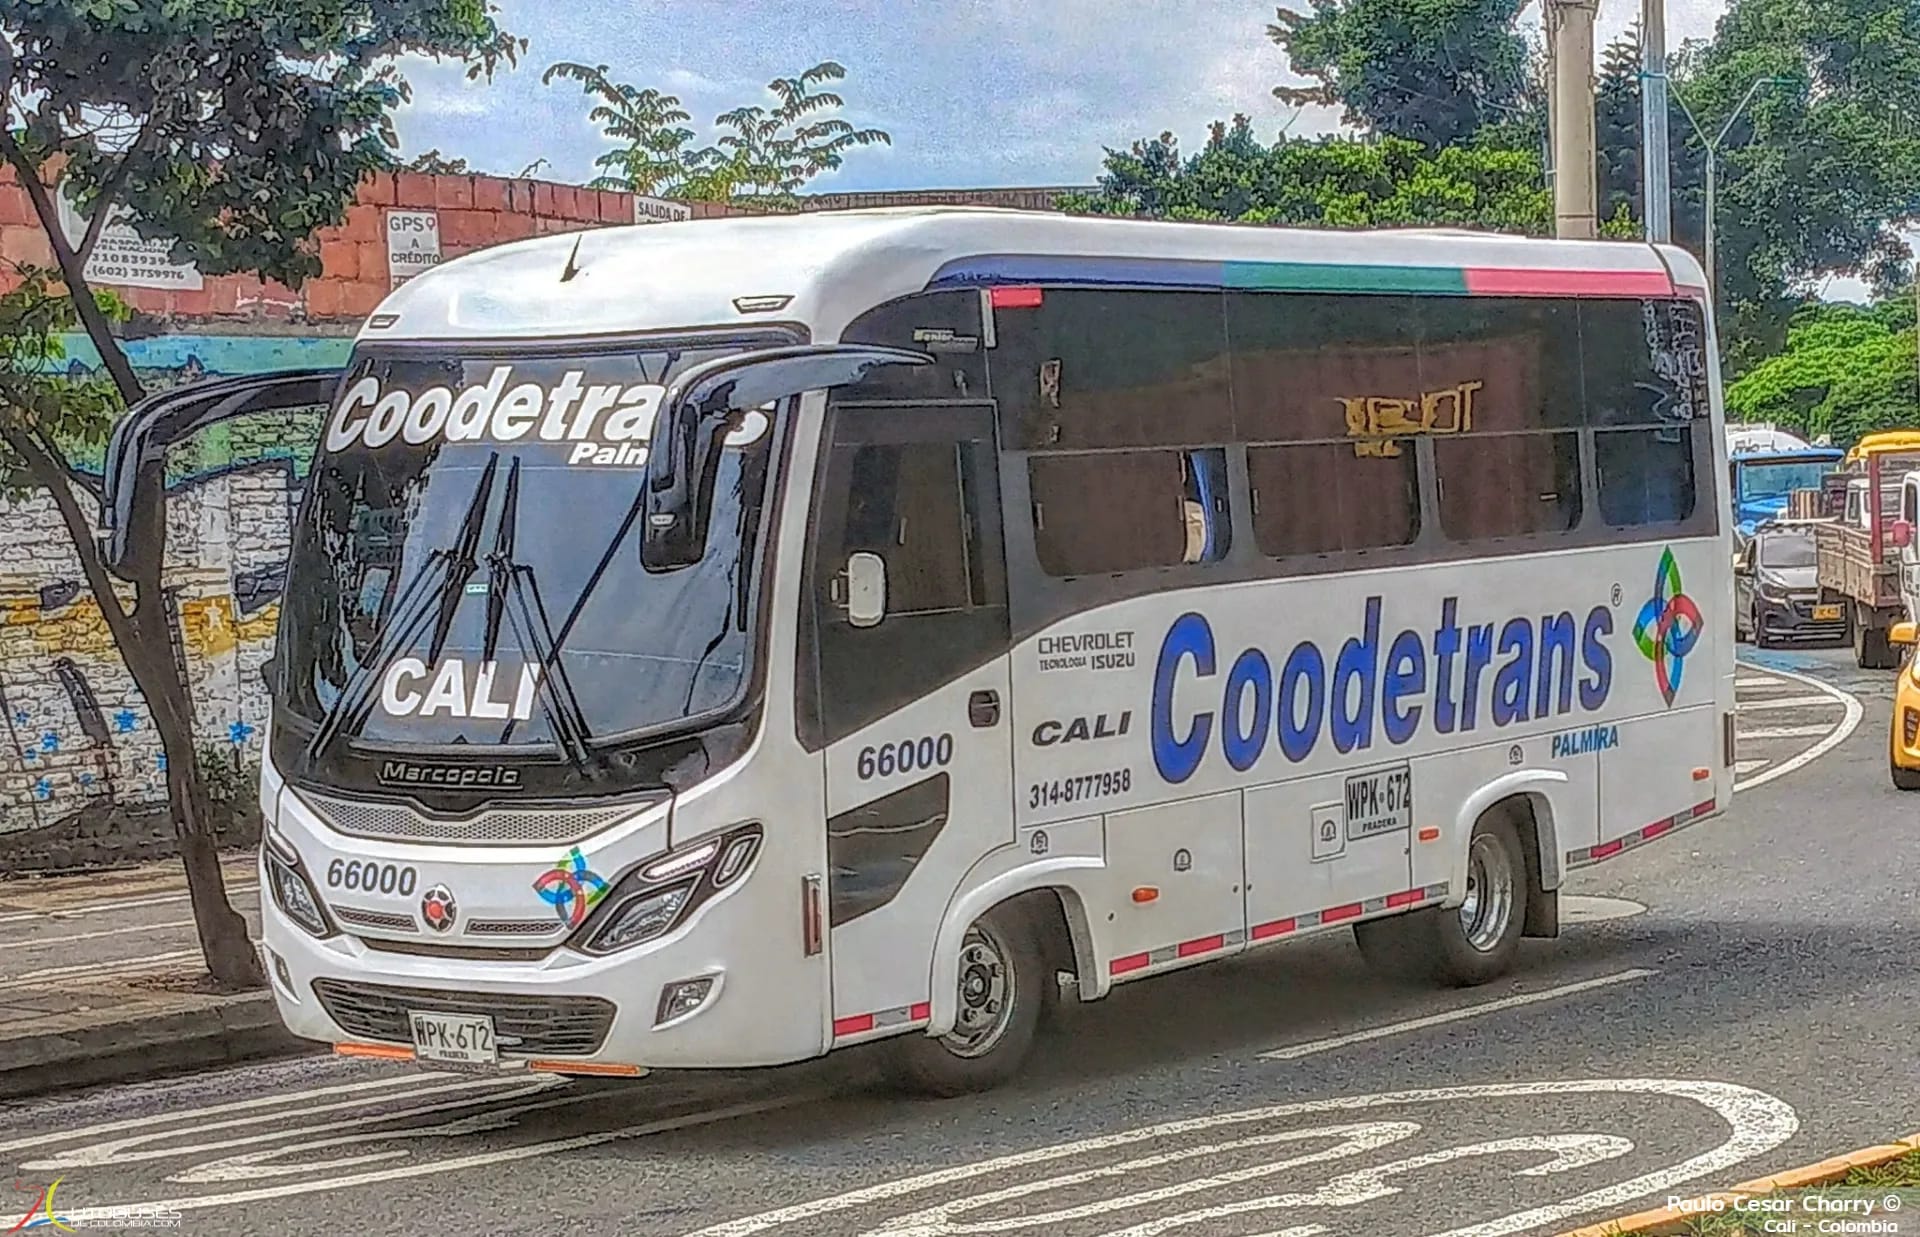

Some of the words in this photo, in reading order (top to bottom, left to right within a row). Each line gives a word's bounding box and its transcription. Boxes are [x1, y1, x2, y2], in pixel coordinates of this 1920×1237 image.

[389, 215, 425, 232] GPS
[638, 201, 672, 222] SALIDA
[411, 238, 420, 248] A
[391, 251, 441, 265] CRÉDITO
[1038, 631, 1135, 655] CHEVROLET
[1091, 652, 1135, 670] ISUZU
[381, 656, 541, 721] CALI
[1150, 595, 1614, 785] Coodetrans
[1031, 710, 1132, 747] CALI
[1551, 725, 1619, 759] PALMIRA
[857, 732, 954, 781] 66000
[382, 760, 519, 785] Marcopolo
[326, 856, 417, 898] 66000
